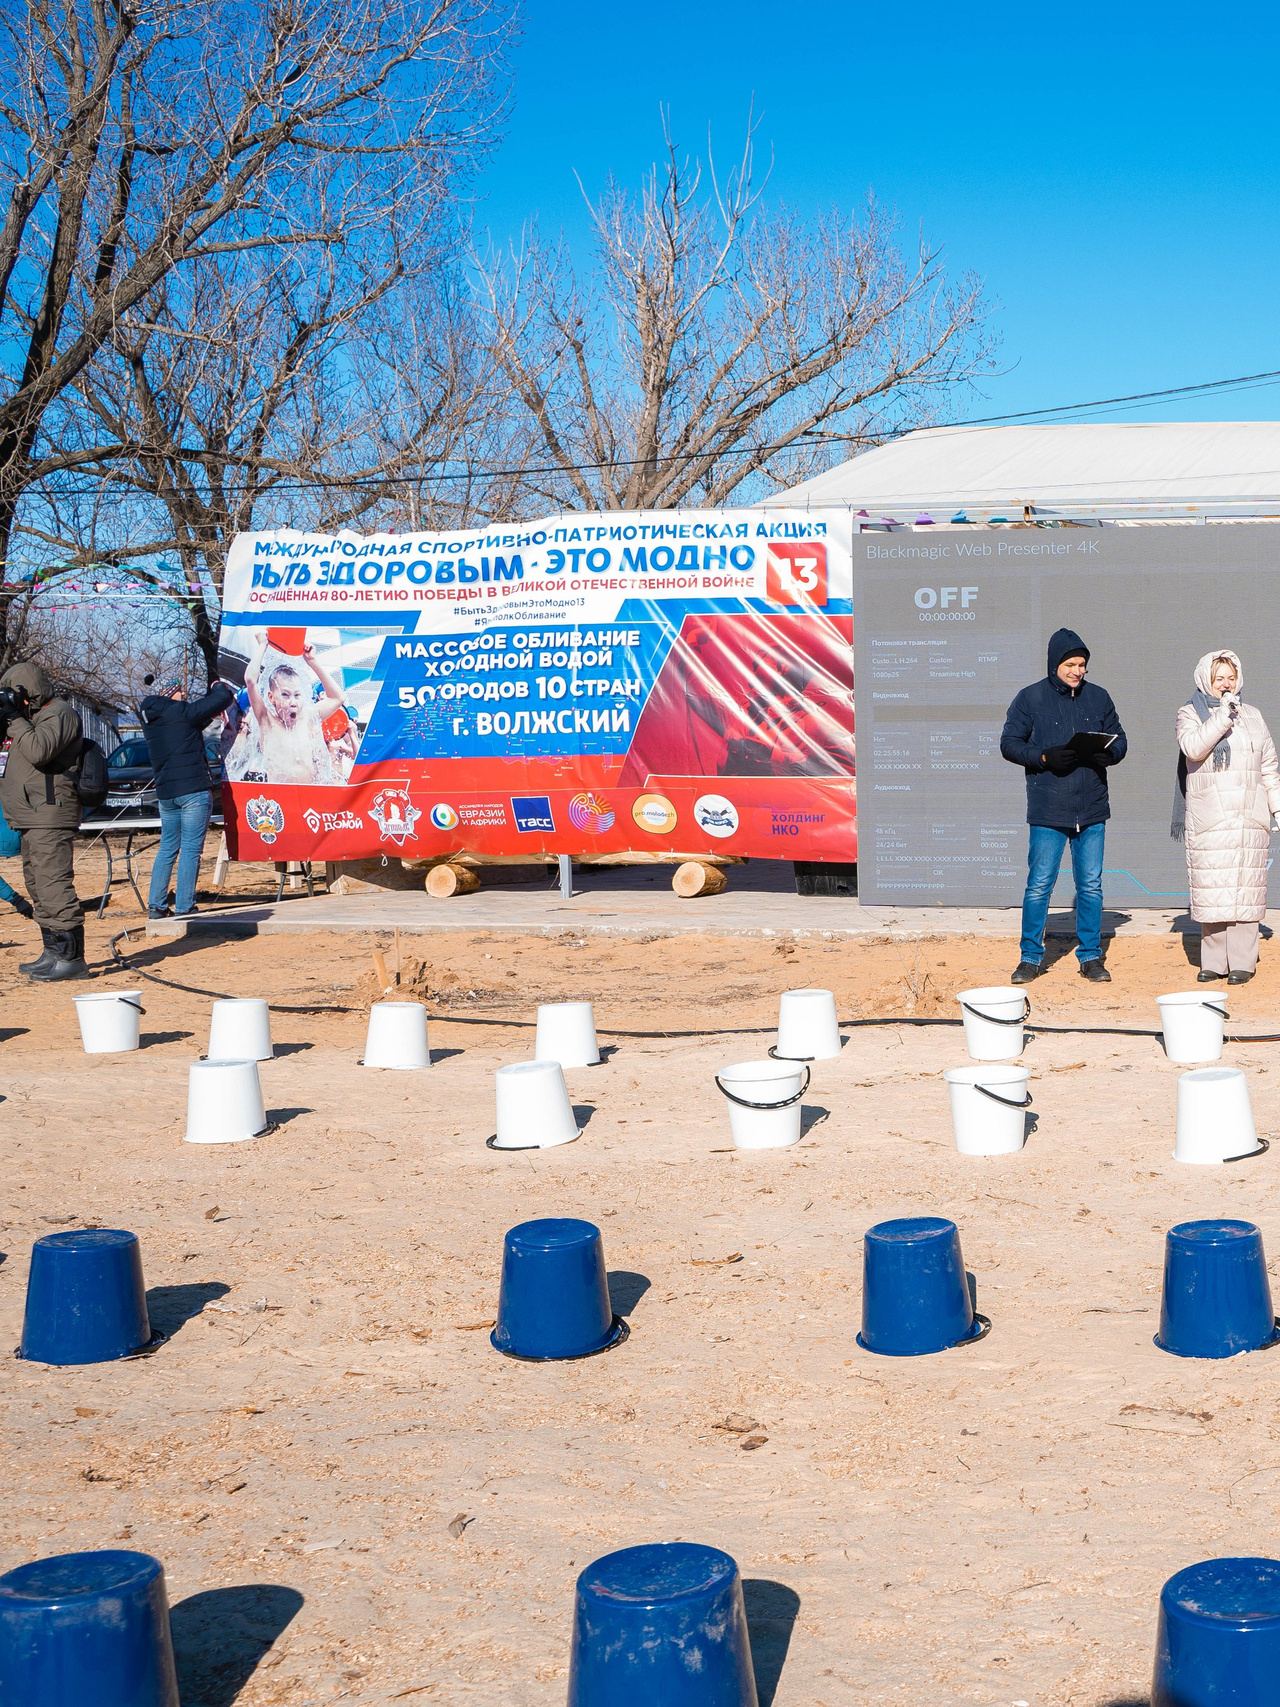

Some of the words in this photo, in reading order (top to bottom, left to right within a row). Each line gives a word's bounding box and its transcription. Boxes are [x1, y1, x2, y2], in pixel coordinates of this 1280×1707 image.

[756, 522, 827, 538] АКЦИЯ
[867, 544, 951, 560] Blackmagic
[956, 543, 992, 556] Web
[998, 541, 1072, 556] Presenter
[1077, 540, 1100, 554] 4K
[316, 554, 525, 586] ЗДОРОВЫМ
[545, 548, 612, 574] ЭТО
[618, 544, 756, 573] МОДНО
[777, 557, 819, 592] 13
[330, 590, 409, 602] 80-ЛЕТИЮ
[413, 587, 483, 601] ПОБЕДЫ
[487, 586, 498, 598] В
[501, 574, 567, 597] ВЕЛИКОЙ
[570, 573, 698, 591] ОТЕЧЕСТВЕННОЙ
[702, 573, 755, 588] ВОЙНЕ
[914, 586, 979, 609] OFF
[918, 612, 976, 621] 00:00:00:00
[512, 630, 641, 648] ОБЛИВАНИЕ
[539, 646, 613, 669] ВОДОЙ
[929, 656, 953, 664] Custom
[929, 670, 960, 678] Streaming
[961, 670, 976, 678] High
[535, 675, 567, 699] 10
[570, 678, 641, 697] СТРАН
[452, 717, 470, 736] г.
[477, 702, 631, 736] ВОЛЖСКИЙ
[322, 810, 354, 822] ПУТЬ
[459, 809, 505, 819] ЕВРАЗИИ
[470, 818, 507, 826] АФРИКИ
[772, 814, 826, 823] ХОЛДИНГ
[324, 817, 363, 832] ДОМОЙ
[772, 824, 799, 836] НКО
